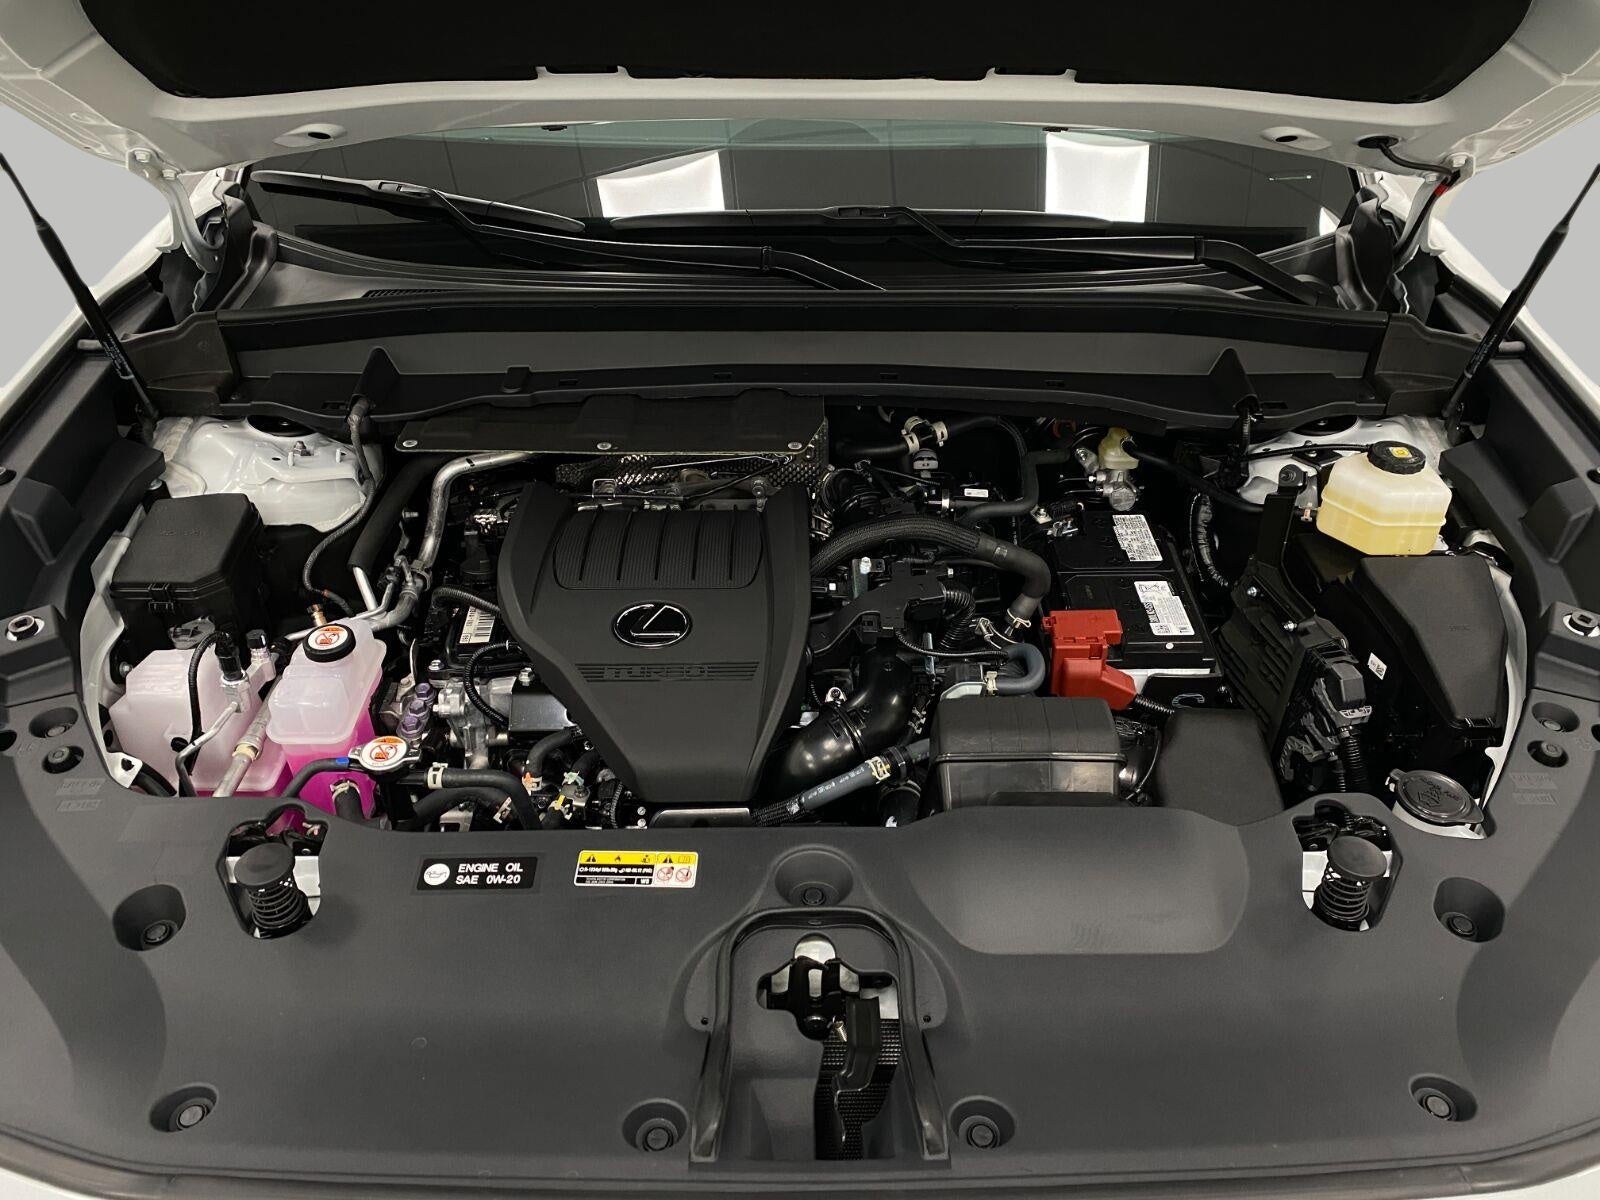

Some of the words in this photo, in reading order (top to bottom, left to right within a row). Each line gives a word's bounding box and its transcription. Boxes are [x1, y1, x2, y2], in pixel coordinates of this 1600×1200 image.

[457, 863, 500, 873] ENGINE
[505, 862, 524, 872] OIL
[455, 874, 480, 885] SAE
[486, 874, 522, 884] 0W-20
